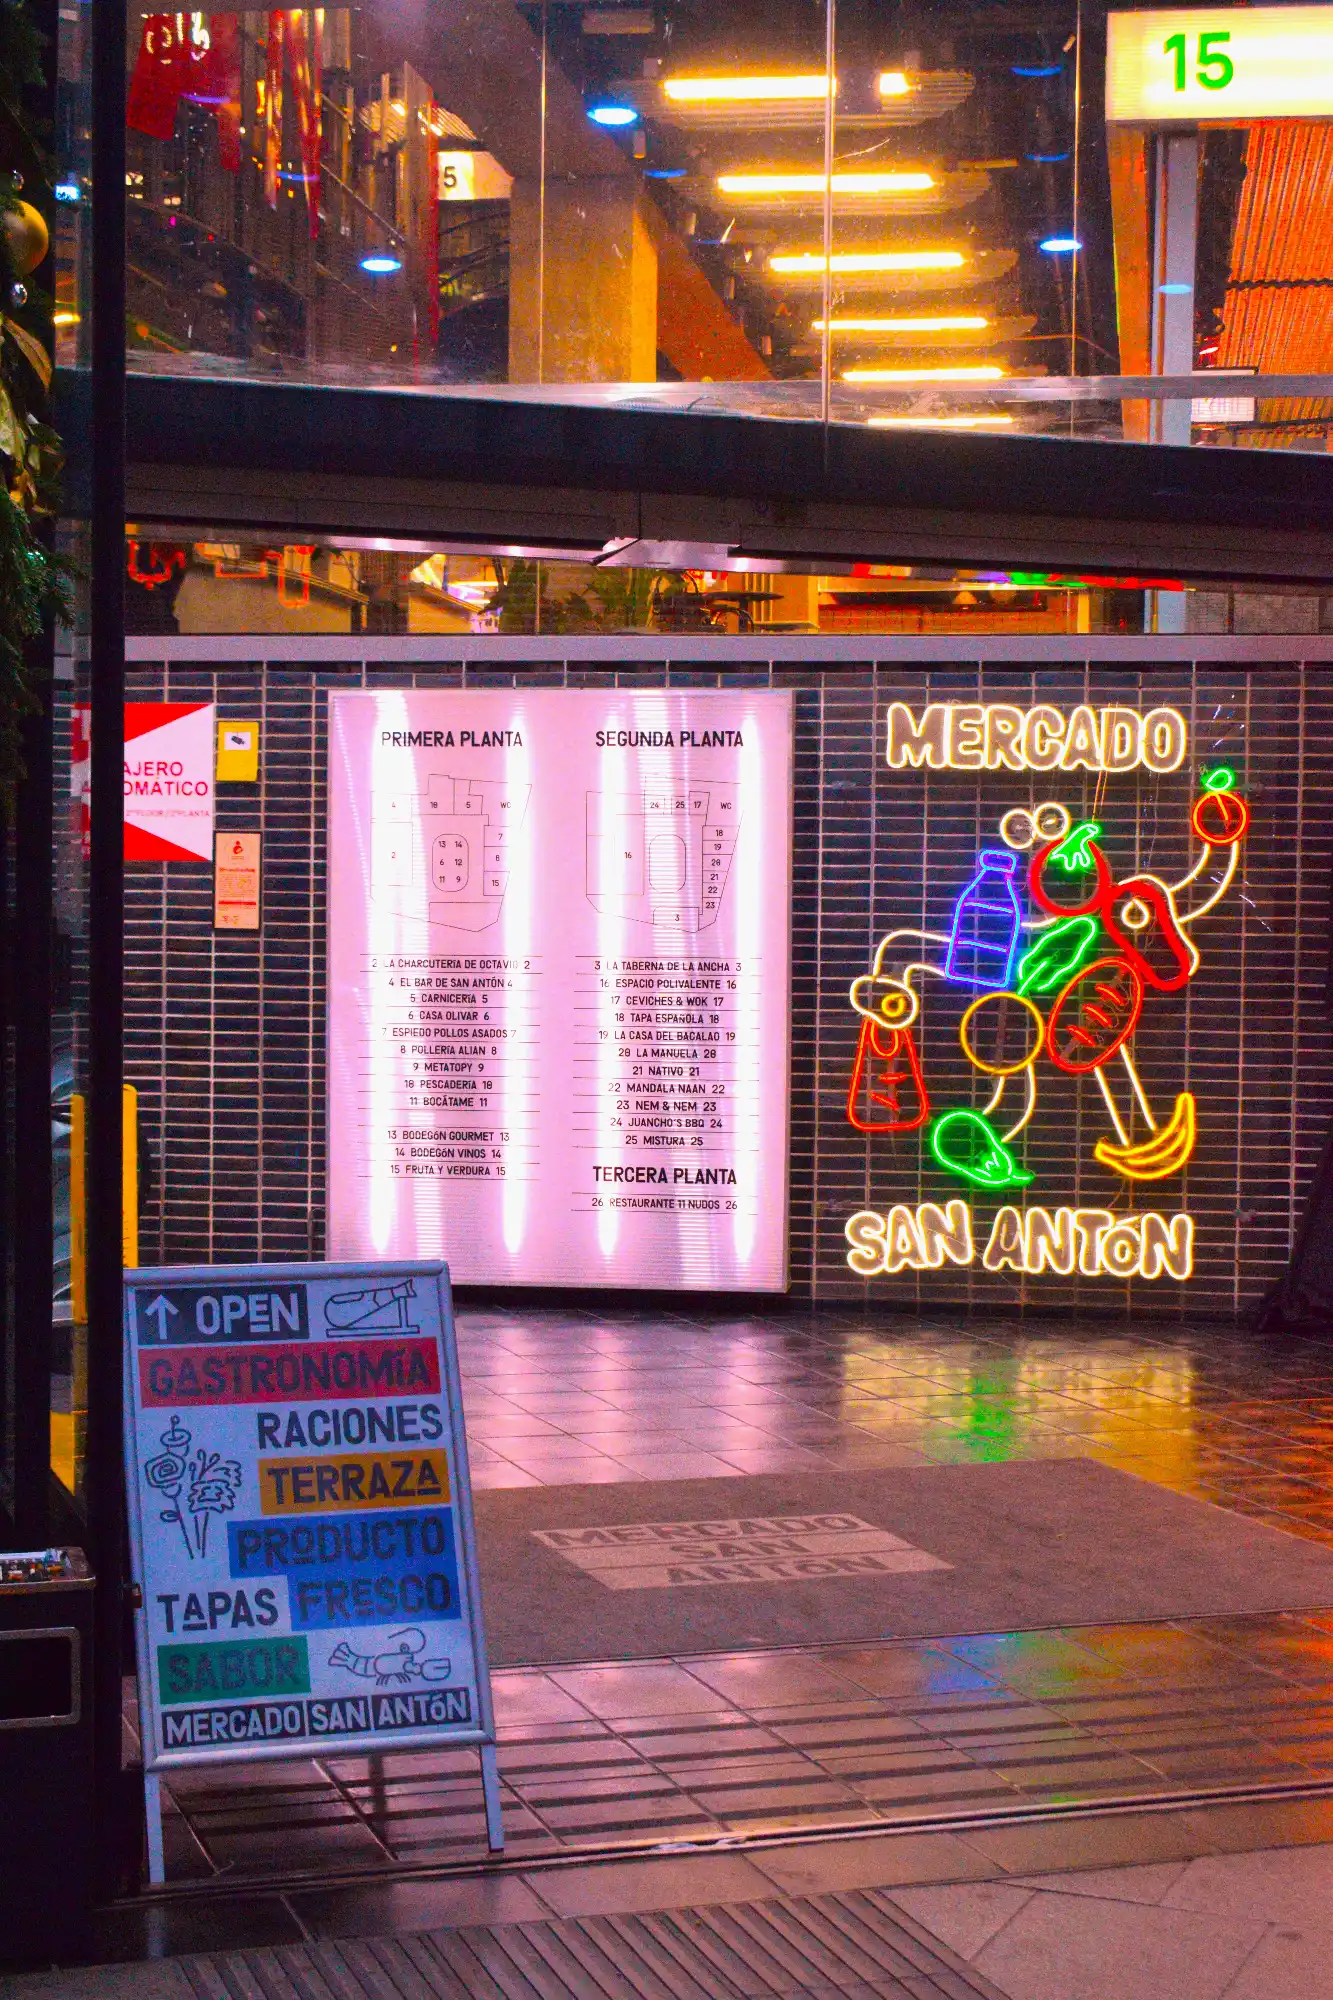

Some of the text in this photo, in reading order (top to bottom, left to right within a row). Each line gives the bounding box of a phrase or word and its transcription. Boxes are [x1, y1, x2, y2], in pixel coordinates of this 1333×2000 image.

[1164, 31, 1234, 91] 15
[443, 166, 458, 189] 5
[382, 731, 523, 747] PRIMERA PLANTA
[595, 731, 744, 747] SEGUNDA PLANTA
[886, 702, 1187, 773] MERCADO
[124, 761, 183, 776] AJERO
[707, 886, 718, 894] 22
[372, 959, 377, 967] 2
[398, 959, 462, 969] CHARCUTERÍA
[464, 960, 477, 969] DE
[524, 960, 530, 969] 2
[595, 961, 600, 970] 3
[622, 961, 664, 971] TABERNA
[667, 962, 679, 971] DE
[682, 962, 694, 971] LA
[698, 962, 730, 971] ANCHA
[735, 963, 742, 971] 3
[389, 978, 394, 986] 4
[400, 978, 411, 986] EL
[415, 978, 432, 987] BAR
[435, 978, 447, 987] DE
[450, 978, 469, 987] SAN
[472, 976, 504, 987] ANTÓN
[616, 979, 654, 988] ESPACIO
[657, 980, 721, 989] POLIVALENTE
[727, 980, 737, 989] 16
[411, 994, 488, 1003] 5 CARNICERÍA 5
[611, 996, 723, 1007] 17 CEVICHES & WOK 17
[408, 1011, 490, 1021] 6 CASA OLIVAR 6
[615, 1013, 719, 1024] 18 TAPA ESPAÑOLA 18
[392, 1028, 431, 1037] ESPIEDO
[434, 1028, 469, 1037] POLLOS
[472, 1029, 507, 1038] ASADOS
[599, 1031, 735, 1041] 19 LA CASA DEL BACALAO 19
[412, 1045, 455, 1055] POLLERÍA
[458, 1046, 486, 1055] ALIAN
[491, 1047, 497, 1055] 8
[636, 1049, 697, 1058] LA MANUELA
[413, 1063, 484, 1072] 9 METATOPY 9
[633, 1067, 700, 1076] 21 NATIVO 21
[420, 1080, 477, 1089] PESCADERÍA
[608, 1083, 725, 1094] 22 MANDALA NAAN 22
[410, 1095, 487, 1107] 11 BOCÁTAME 11
[617, 1100, 716, 1111] 23 NEM & NEM 23
[610, 1118, 622, 1126] 24
[685, 1119, 704, 1128] BBQ
[710, 1119, 722, 1128] 24
[387, 1131, 509, 1141] 13 BODEGÓN GOURMET 13
[626, 1135, 703, 1145] 25 MISTURA 25
[396, 1148, 501, 1158] 14 BODEGÓN VINOS 14
[391, 1165, 505, 1175] 15 FRUTA Y VERDURA 15
[593, 1166, 737, 1184] TERCERA PLANTA
[592, 1198, 603, 1207] 26
[610, 1198, 674, 1208] RESTAURANTE
[688, 1200, 720, 1209] NUDOS
[726, 1201, 737, 1209] 26
[844, 1200, 1193, 1280] SAN ANTÓN
[196, 1293, 300, 1335] OPEN
[150, 1348, 432, 1398] GASTRONOMÍA
[257, 1403, 443, 1450] RACIONES
[267, 1459, 441, 1504] TERRAZA
[544, 1515, 862, 1547] MERCADO
[236, 1516, 445, 1569] PRODUCTO
[669, 1539, 813, 1560] SAN
[664, 1556, 890, 1586] ANTÓN
[297, 1572, 451, 1621] FRESCO
[156, 1588, 279, 1632] TAPAS
[169, 1644, 300, 1694] SABOR
[166, 1692, 468, 1745] MERCADO SAN ANTÓN
